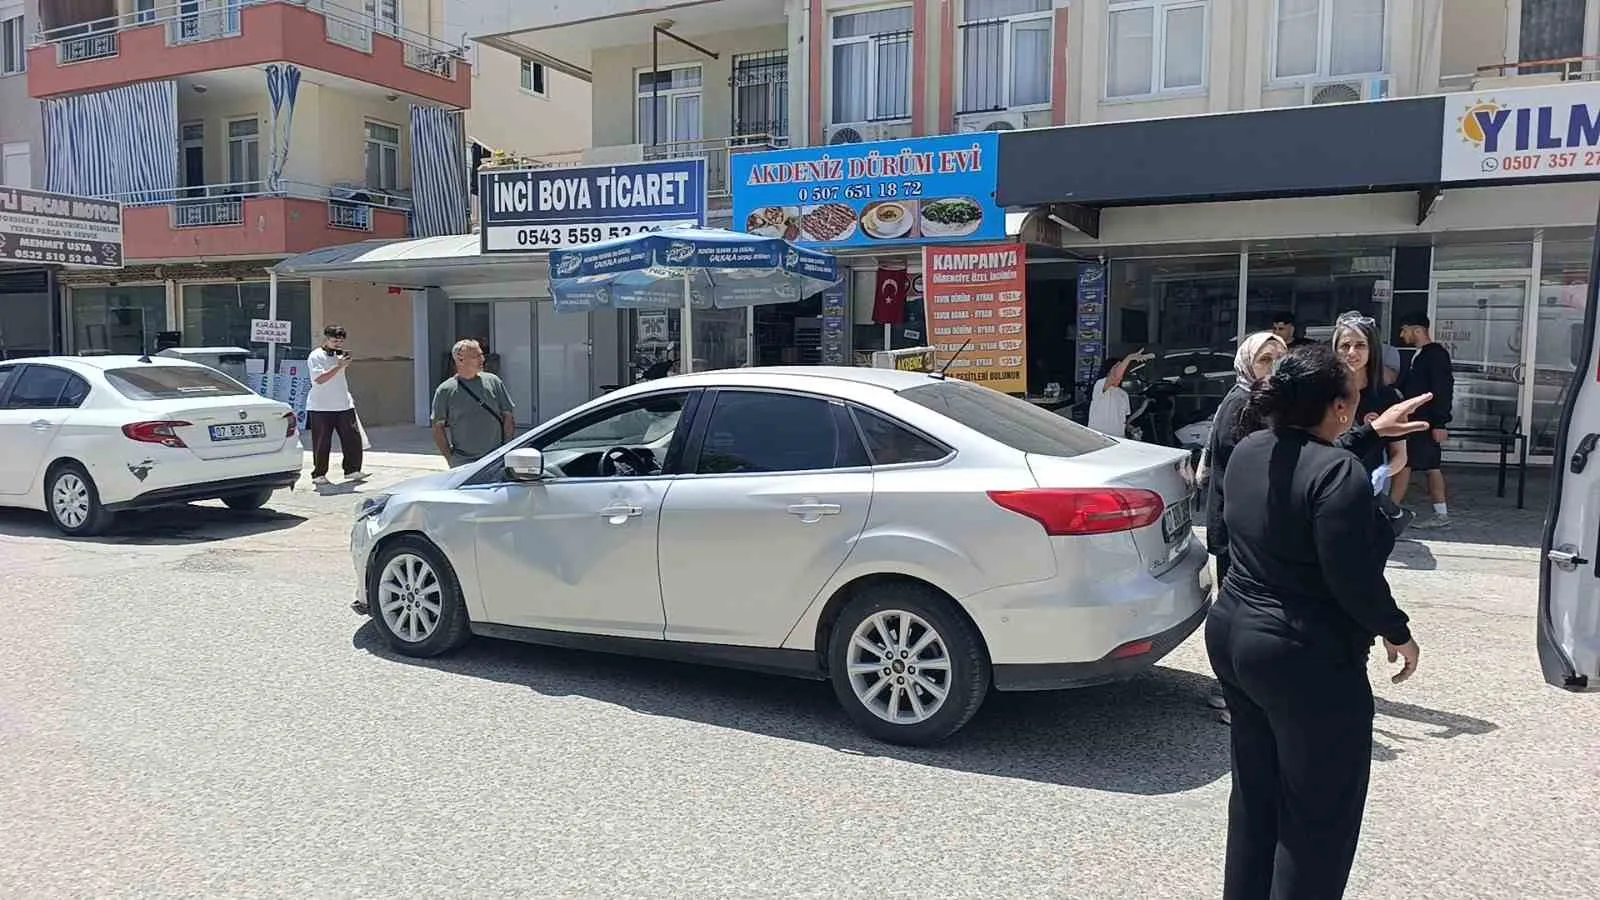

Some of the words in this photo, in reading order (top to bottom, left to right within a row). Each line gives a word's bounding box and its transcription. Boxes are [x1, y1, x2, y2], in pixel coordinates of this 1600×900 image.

[1474, 104, 1600, 153] YILM
[747, 154, 842, 186] AKDENİZ
[849, 149, 935, 179] DÜRÜM
[939, 143, 982, 172] EVİ
[1502, 155, 1541, 171] 0507
[1548, 153, 1577, 168] 357
[493, 172, 533, 213] İNCİ
[539, 176, 592, 212] BOYA
[597, 167, 689, 210] TİCARET
[799, 188, 808, 201] 0
[812, 186, 840, 201] 507
[845, 184, 872, 199] 651
[879, 182, 897, 197] 18
[904, 181, 922, 196] 72
[72, 202, 119, 222] MOTOR
[20, 238, 65, 250] MEHMET
[67, 242, 92, 252] USTA
[517, 227, 561, 245] 0543
[567, 226, 601, 244] 559
[14, 249, 43, 260] 0532
[69, 254, 82, 263] 52
[933, 250, 1017, 271] KAMPANYA
[255, 321, 287, 329] KIRALIK
